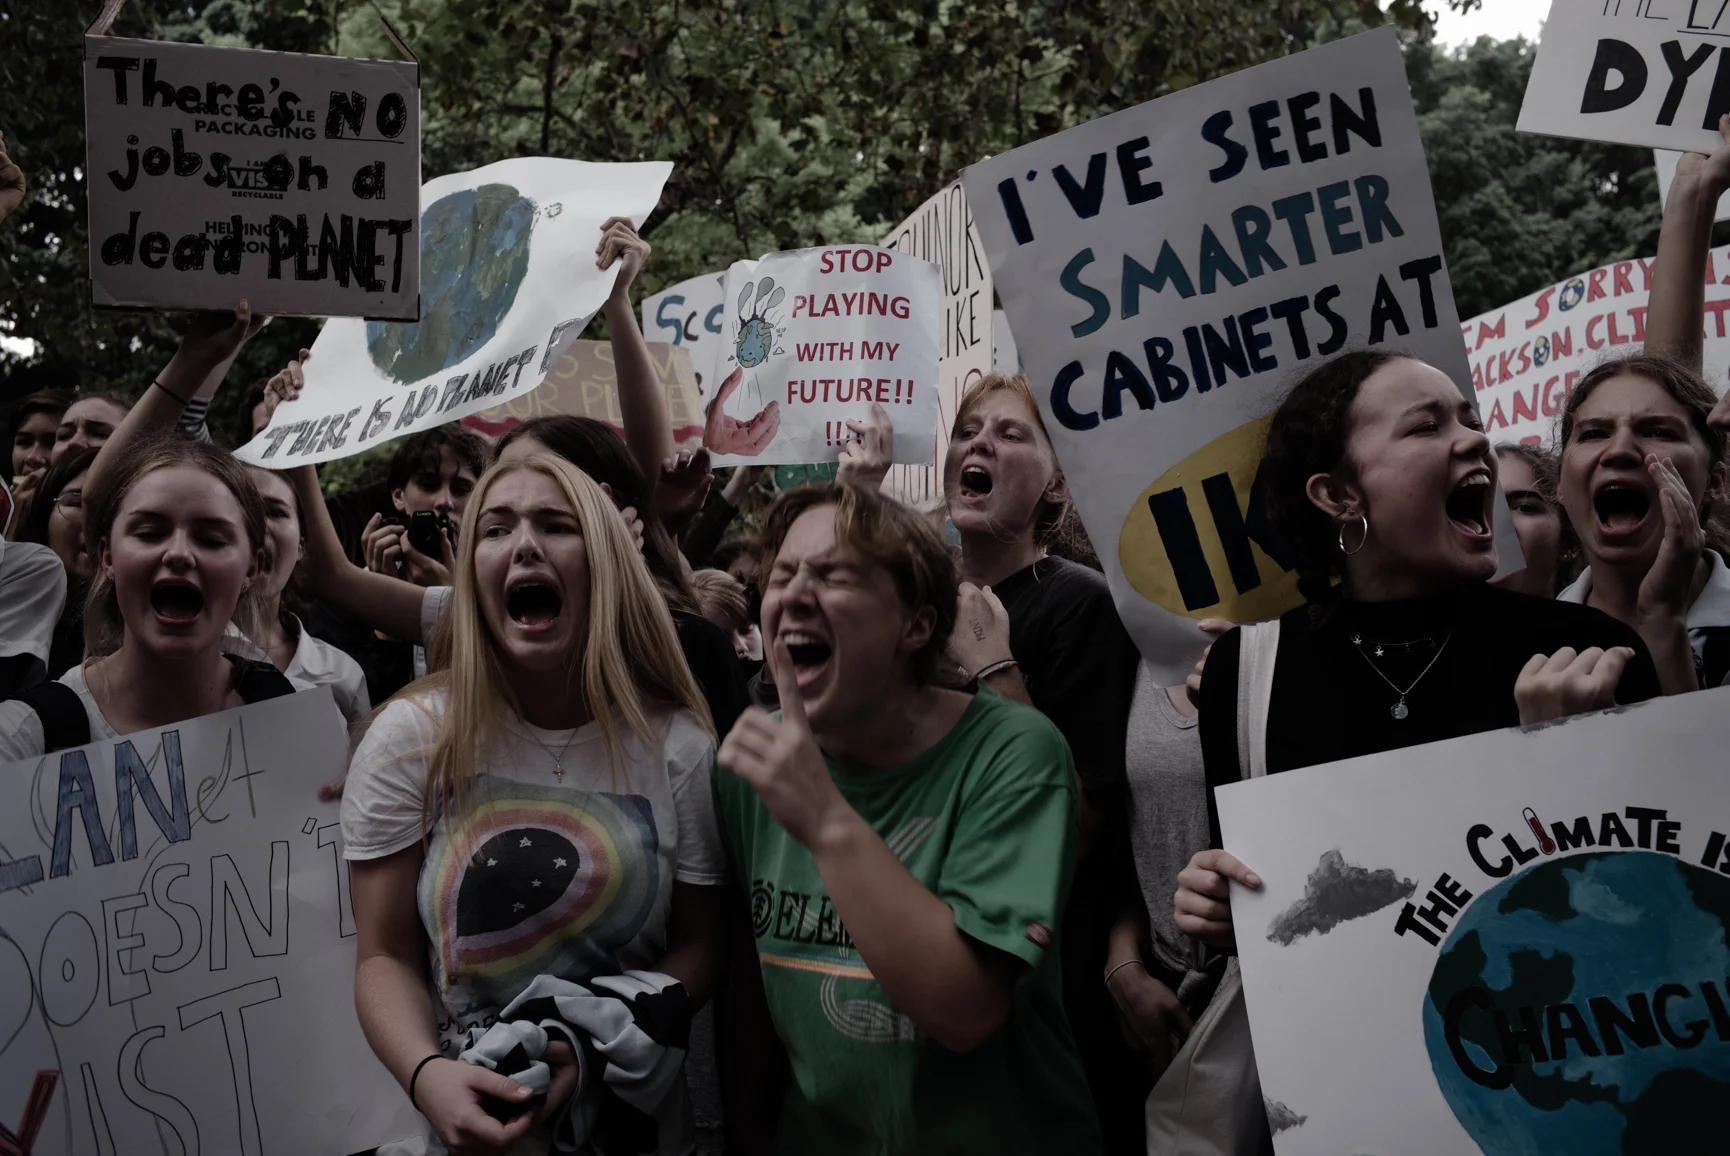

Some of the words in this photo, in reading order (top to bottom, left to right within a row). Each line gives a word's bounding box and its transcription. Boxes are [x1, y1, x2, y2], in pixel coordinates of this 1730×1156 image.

[96, 56, 301, 129] There's
[324, 90, 407, 139] NO
[194, 119, 317, 140] PACKAGING
[107, 128, 231, 191] jobs
[352, 161, 386, 200] a
[229, 170, 282, 189] VIS
[997, 136, 1163, 246] I'VE
[1202, 86, 1382, 183] SEEN
[101, 211, 242, 274] dead
[268, 213, 412, 293] PLANET
[820, 249, 892, 275] STOP
[1060, 174, 1404, 339] SMARTER
[791, 292, 911, 319] PLAYING
[939, 290, 981, 362] IKE
[1525, 257, 1656, 329] SORRY
[796, 342, 854, 362] WITH
[860, 341, 900, 362] MY
[1050, 284, 1348, 432] CABINETS
[1368, 255, 1442, 345] AT
[261, 405, 362, 459] THERE
[358, 395, 394, 442] IS
[394, 384, 438, 431] NO
[435, 345, 538, 414] PLANET
[787, 378, 914, 405] FUTURE!!
[1394, 872, 1473, 947] THE
[1466, 806, 1681, 878] CLIMATE
